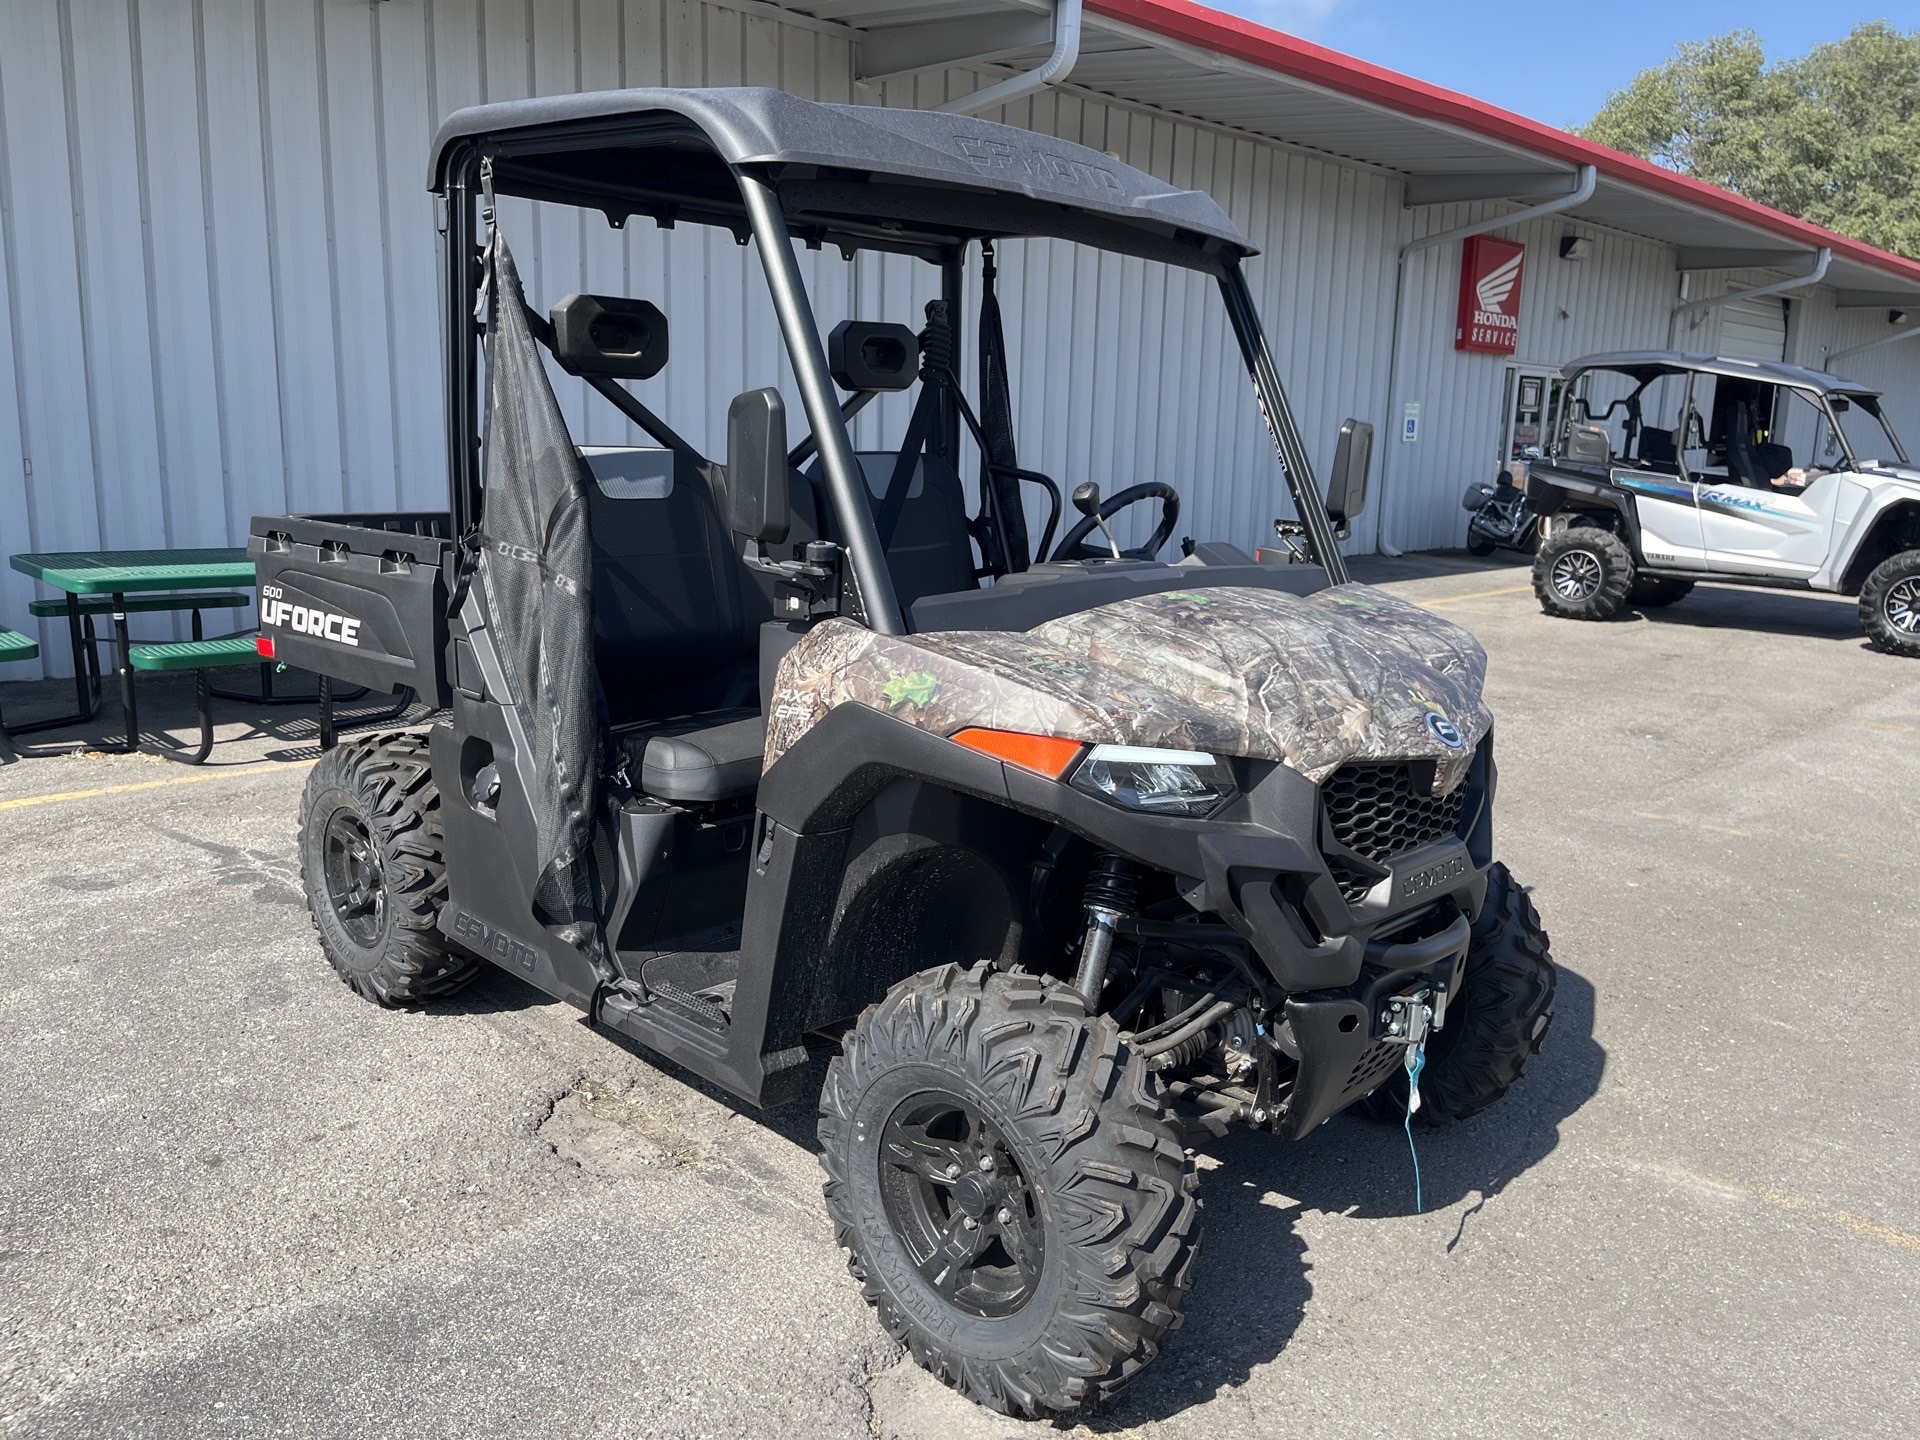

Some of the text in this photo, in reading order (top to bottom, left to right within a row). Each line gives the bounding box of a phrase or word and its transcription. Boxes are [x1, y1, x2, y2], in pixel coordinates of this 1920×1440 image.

[953, 135, 1126, 197] CFMOTO
[1474, 310, 1518, 329] HONDA
[1472, 327, 1517, 346] SERVICE
[1647, 553, 1675, 562] YAMAHA
[262, 584, 283, 599] 600
[261, 597, 361, 647] UFORCE
[775, 704, 814, 720] EPS
[1403, 856, 1465, 898] CFMOTO
[455, 907, 539, 973] CFMOTO
